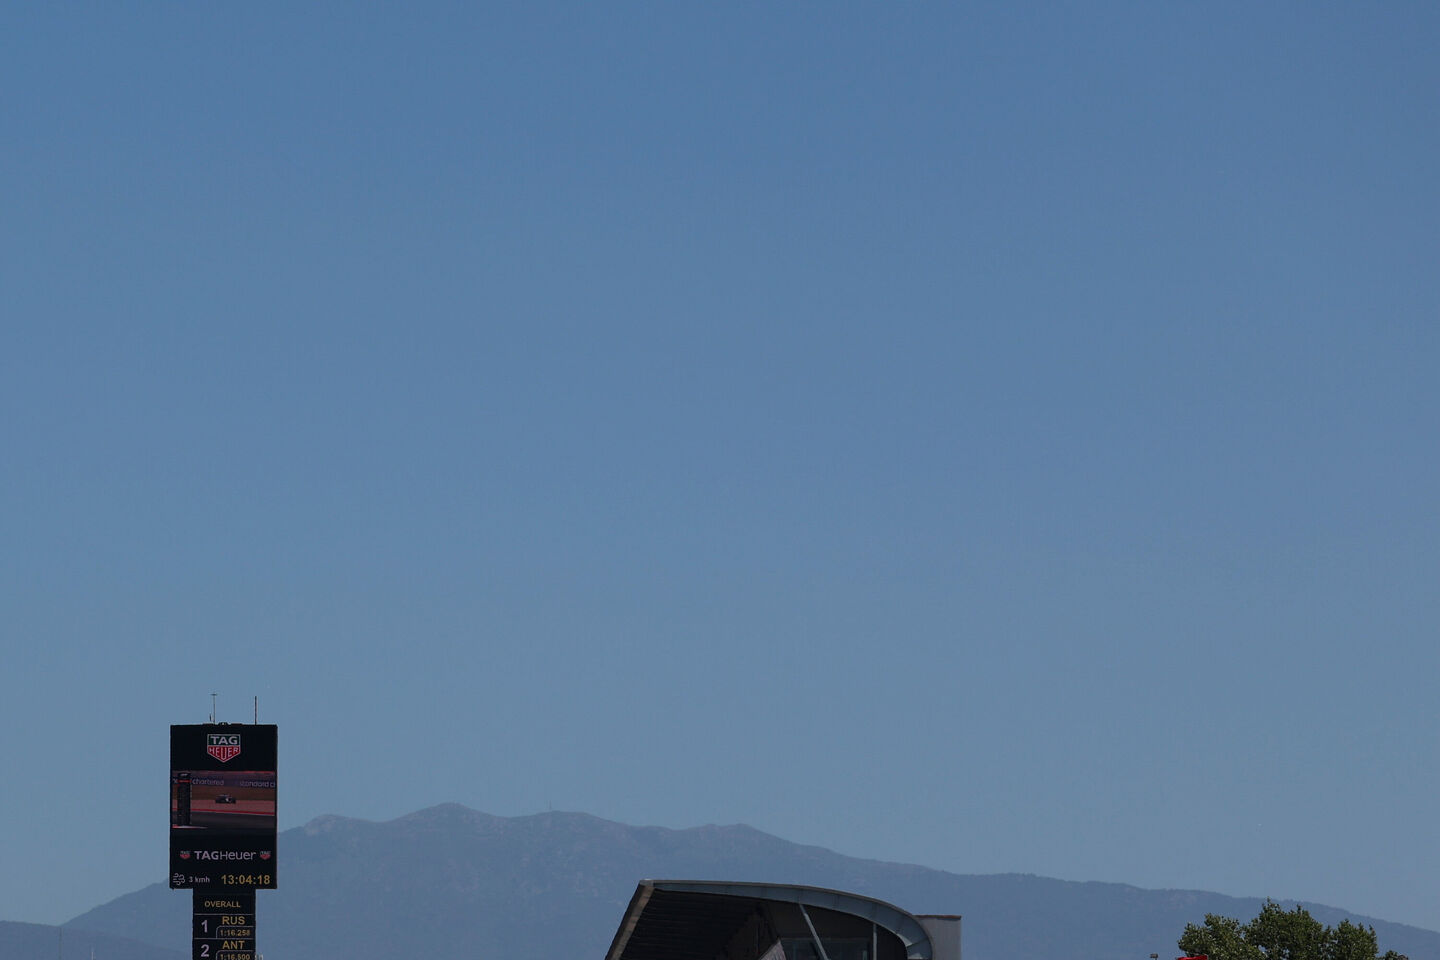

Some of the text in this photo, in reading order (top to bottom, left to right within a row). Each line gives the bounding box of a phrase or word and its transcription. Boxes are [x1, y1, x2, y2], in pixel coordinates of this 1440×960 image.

[210, 736, 238, 745] TAG
[208, 746, 239, 760] HEUER
[194, 851, 256, 860] TAGHeuer
[221, 874, 270, 885] 13:04:18
[201, 916, 246, 933] 1 RUS
[201, 941, 245, 957] 2 ANT
